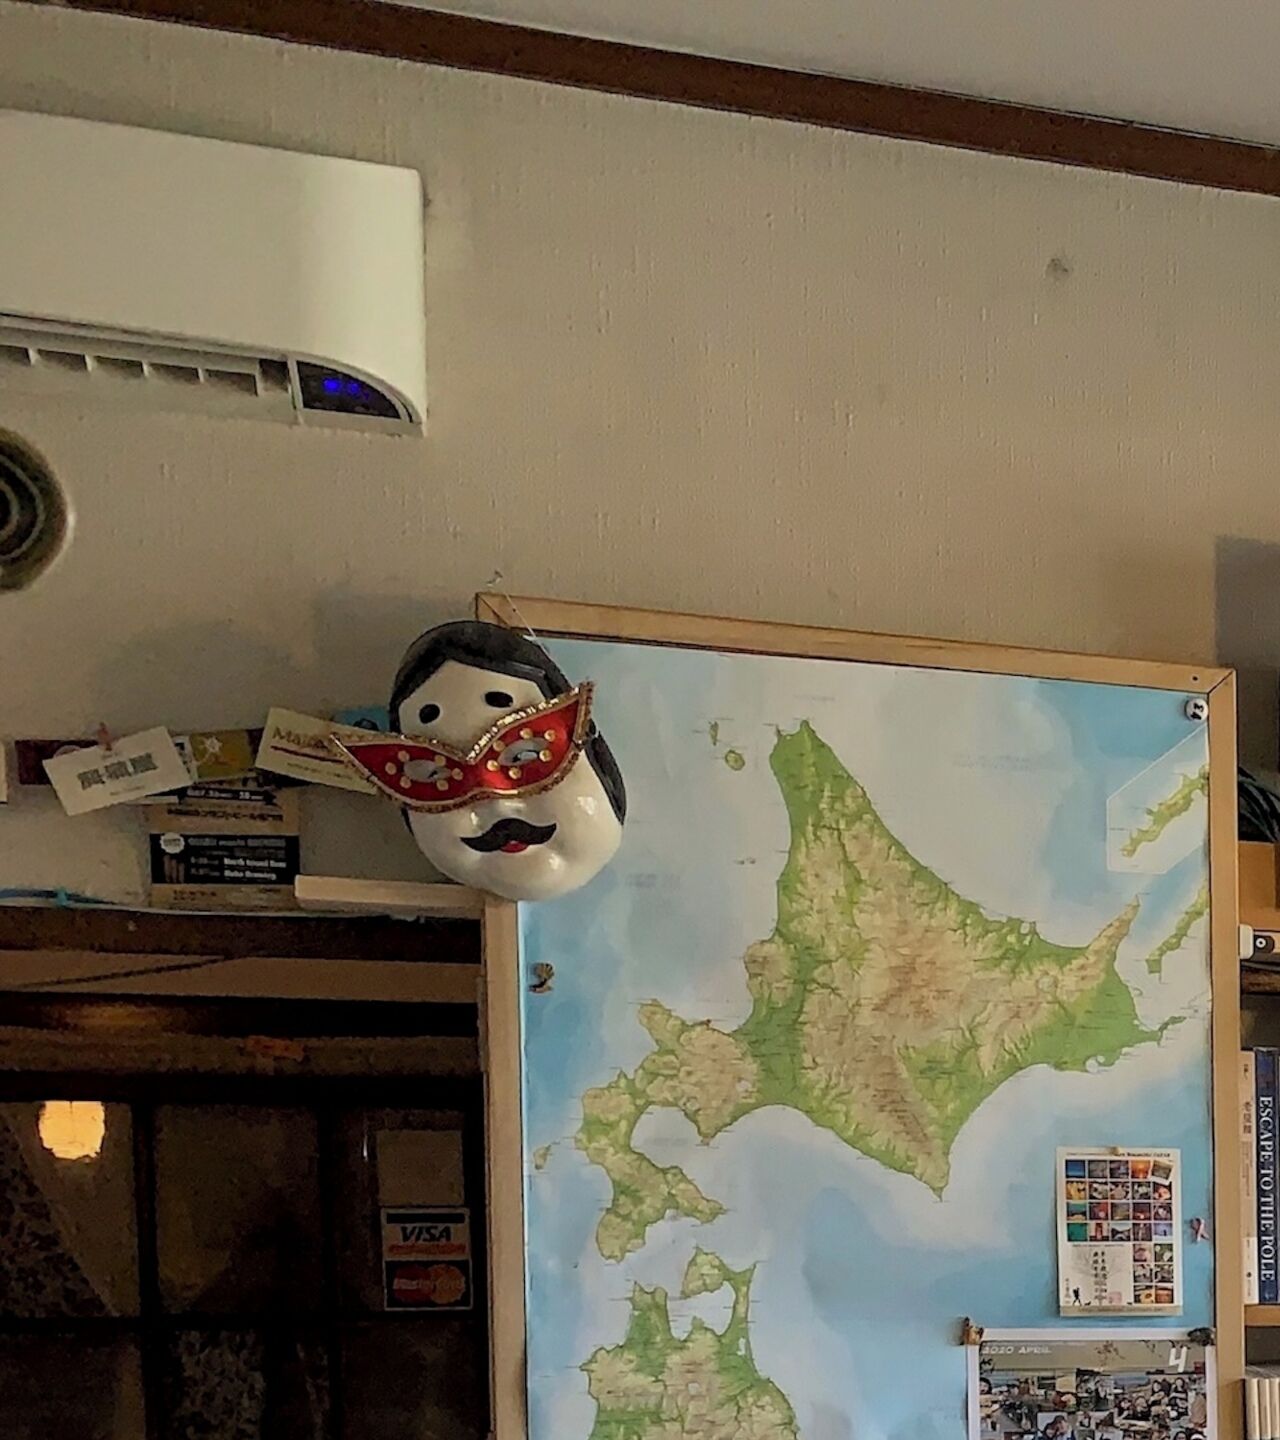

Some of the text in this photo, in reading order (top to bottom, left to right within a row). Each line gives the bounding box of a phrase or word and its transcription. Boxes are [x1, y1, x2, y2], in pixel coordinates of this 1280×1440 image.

[1259, 1096, 1276, 1281] ESCAPE TO THE POLE
[400, 1225, 452, 1242] VISA
[1168, 1345, 1188, 1373] 4
